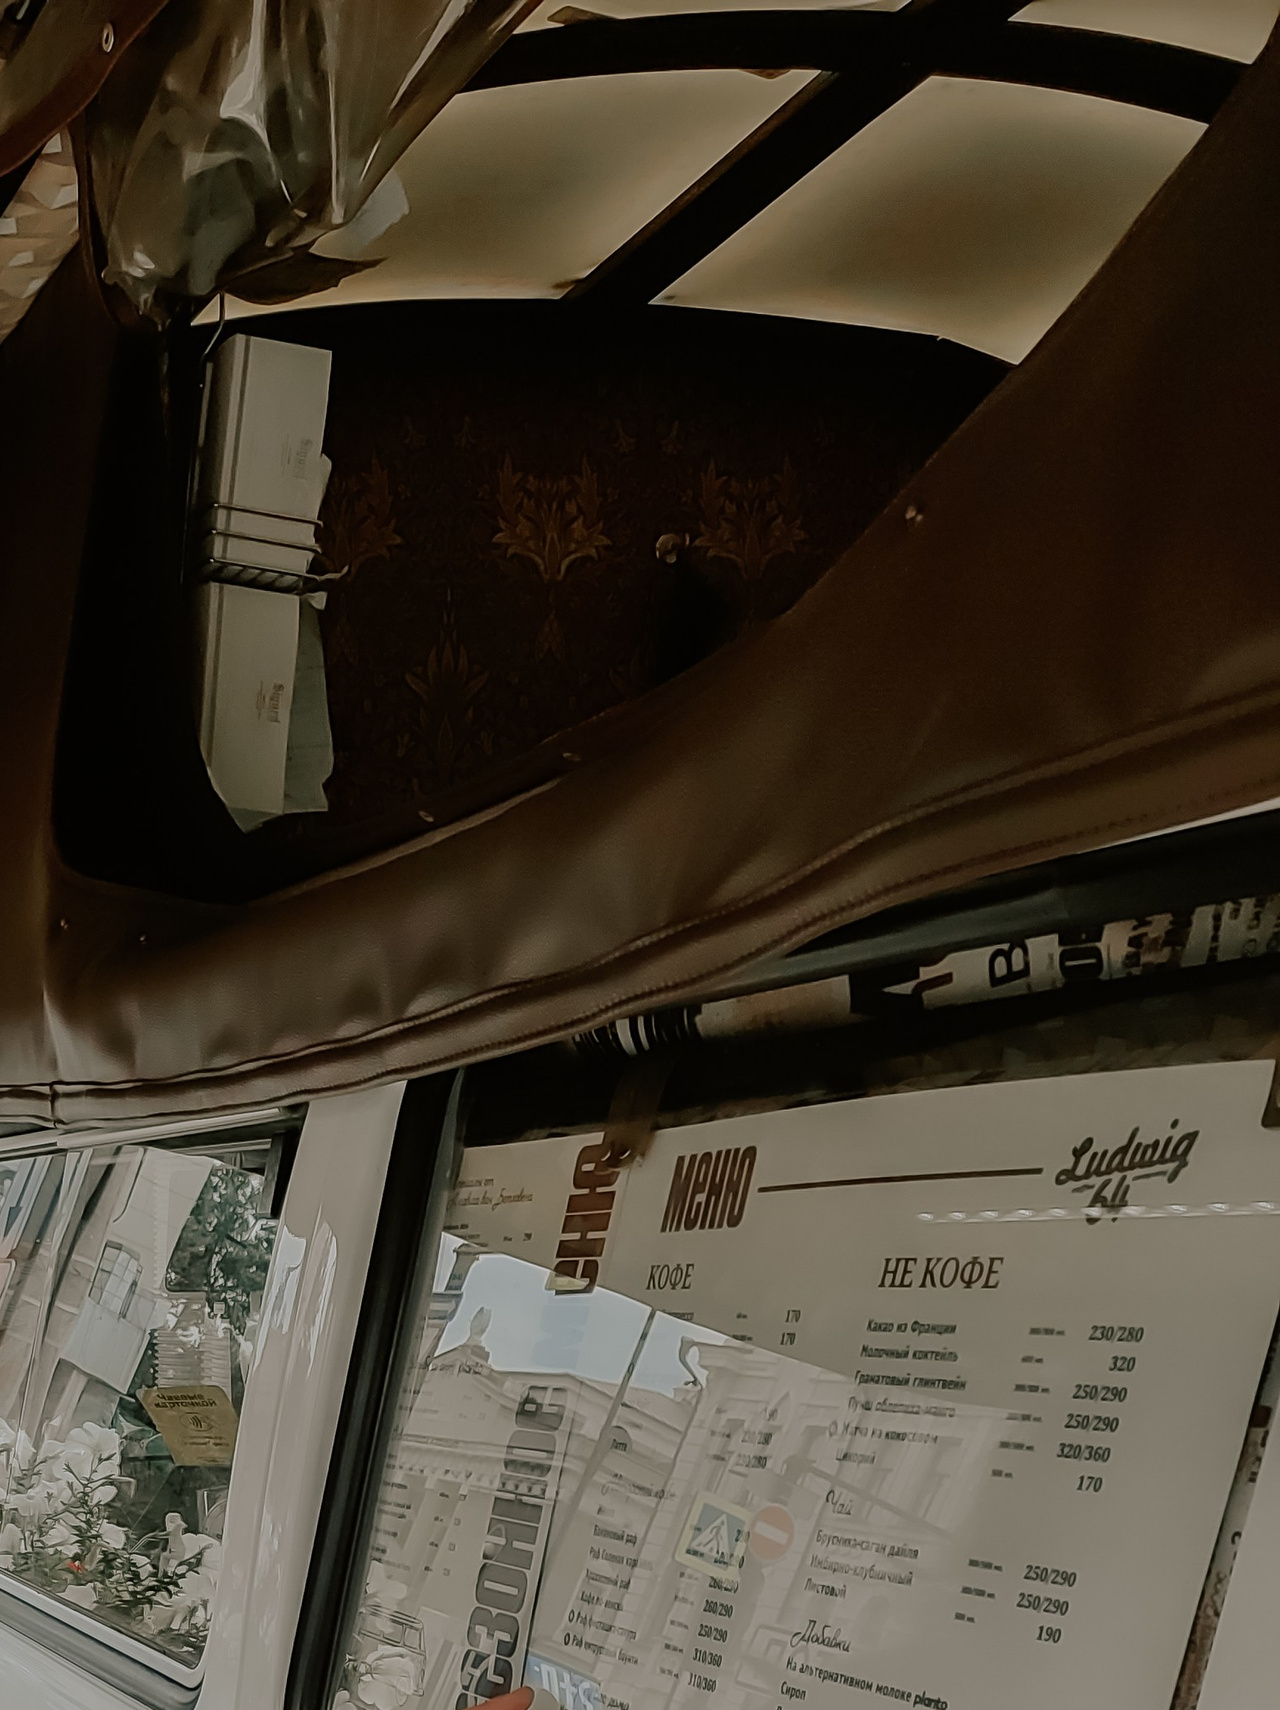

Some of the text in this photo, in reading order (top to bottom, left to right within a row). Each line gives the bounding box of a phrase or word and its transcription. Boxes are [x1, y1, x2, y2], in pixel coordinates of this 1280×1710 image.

[1055, 1119, 1199, 1185] Ludwig
[645, 1263, 695, 1290] КОФЕ
[878, 1256, 1005, 1291] НЕ КОФЕ
[866, 1319, 893, 1334] Какао
[910, 1320, 957, 1336] Франции
[1088, 1325, 1144, 1343] 230/280
[860, 1344, 1136, 1372] Молочный коктейль 320
[1072, 1384, 1127, 1403] 250/290
[1064, 1413, 1119, 1433] 250/290
[1057, 1443, 1111, 1463] 320/360
[1077, 1475, 1103, 1493] 170
[1023, 1565, 1077, 1587] 250/290
[1016, 1592, 1069, 1616] 250/290
[697, 1624, 728, 1643] 250/290
[1036, 1624, 1062, 1644] 190
[692, 1647, 722, 1667] 310/360
[786, 1656, 797, 1672] На
[799, 1663, 873, 1692] альтернативном
[875, 1682, 912, 1703] молоке
[780, 1681, 807, 1701] Сироп
